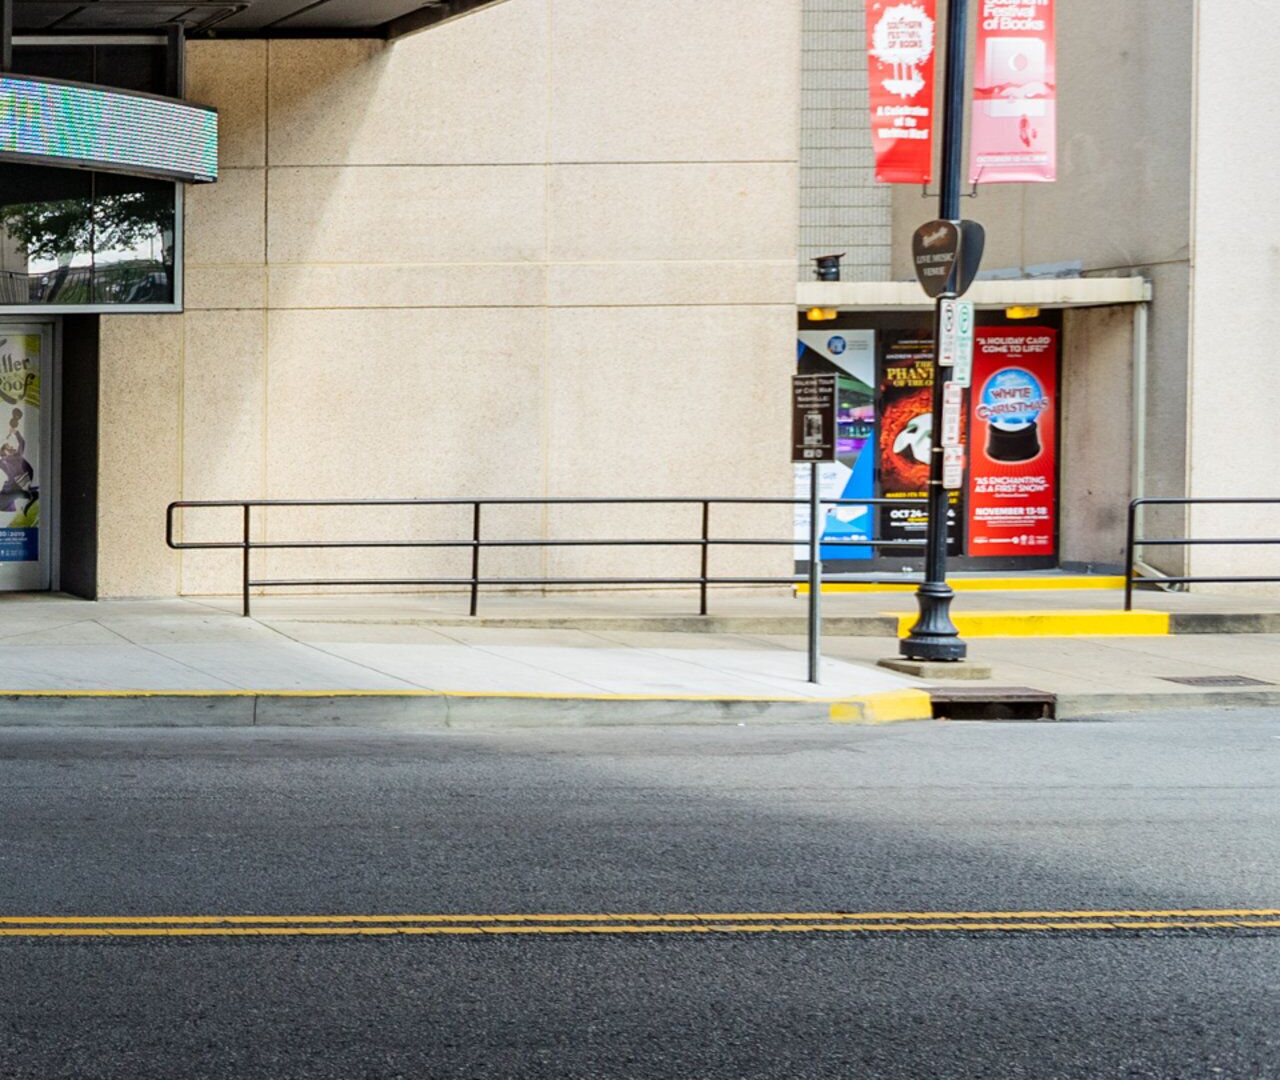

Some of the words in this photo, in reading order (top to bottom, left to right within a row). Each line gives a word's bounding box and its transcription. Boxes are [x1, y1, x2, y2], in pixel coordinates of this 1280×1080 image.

[983, 4, 1035, 17] Festival
[983, 17, 998, 30] of
[1000, 17, 1044, 30] Books
[991, 388, 1031, 399] WHITE
[977, 399, 1048, 419] CHRISTMAS
[890, 510, 909, 518] OCT
